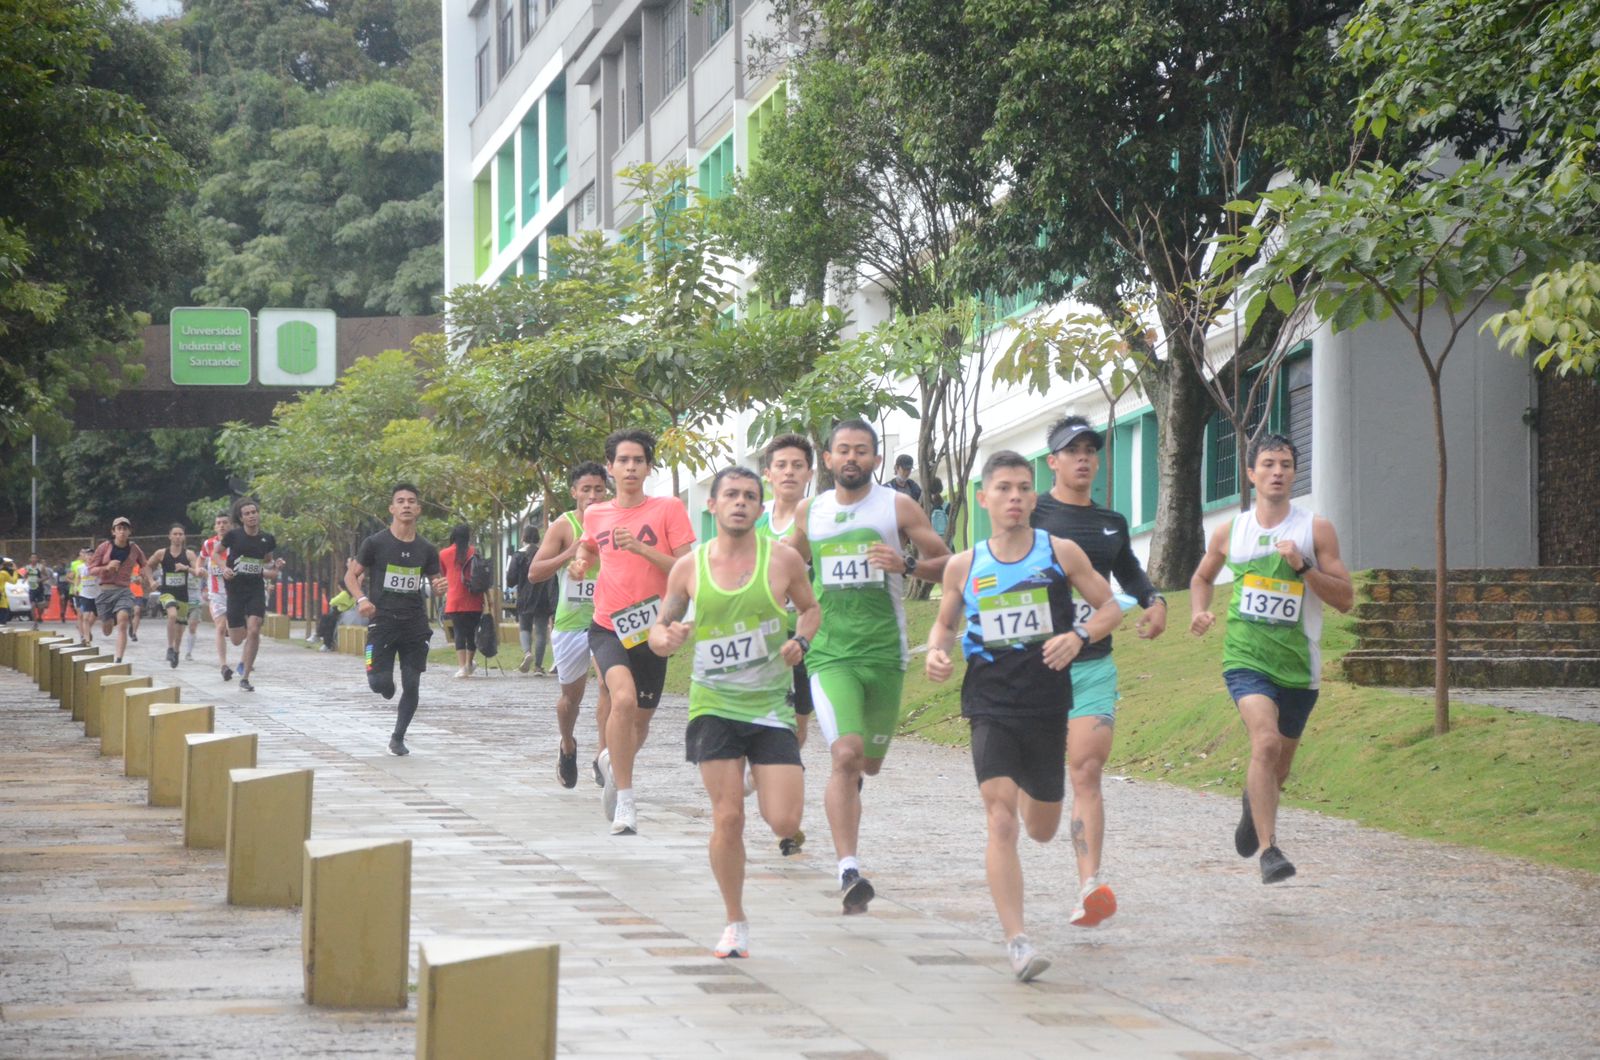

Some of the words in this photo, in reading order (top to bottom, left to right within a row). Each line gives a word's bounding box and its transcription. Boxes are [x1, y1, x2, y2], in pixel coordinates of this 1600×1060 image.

[182, 325, 242, 336] Universidad
[179, 341, 226, 351] Industrial
[228, 341, 241, 351] de
[190, 356, 241, 367] Santander
[596, 524, 658, 550] FIA
[242, 564, 259, 573] 488
[832, 559, 870, 580] 441
[390, 575, 415, 589] 816
[576, 582, 595, 597] 18
[1245, 592, 1297, 618] 1376
[616, 604, 658, 634] 1433
[994, 609, 1040, 636] 174
[710, 636, 752, 665] 947
